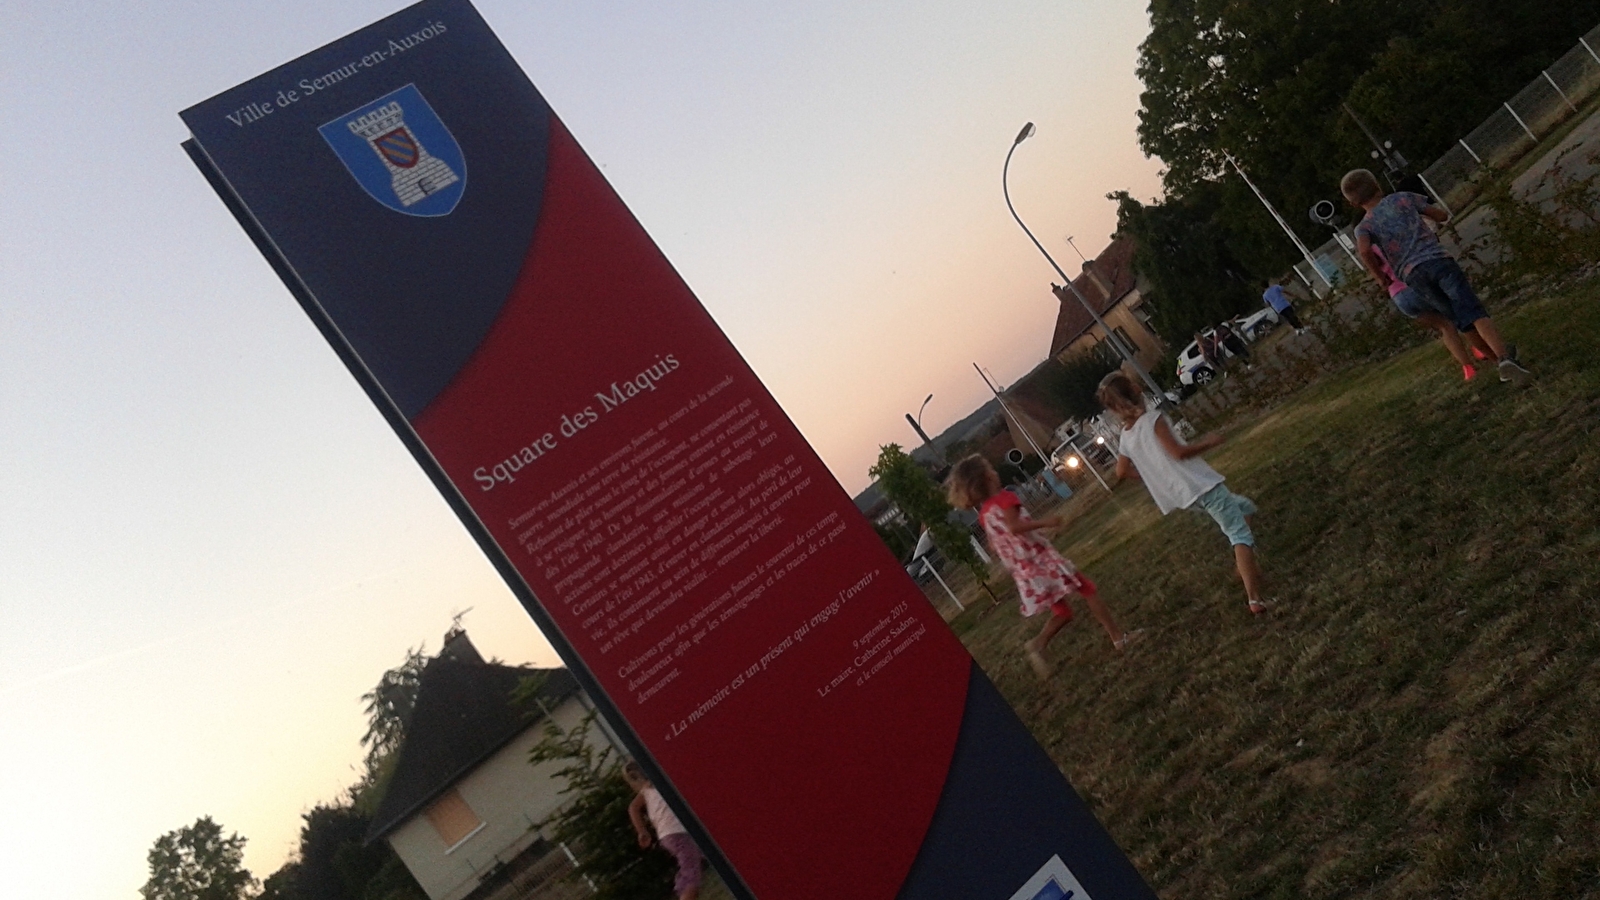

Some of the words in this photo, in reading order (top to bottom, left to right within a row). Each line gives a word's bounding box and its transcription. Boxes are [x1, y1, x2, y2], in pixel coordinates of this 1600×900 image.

[225, 101, 274, 128] Ville
[276, 90, 300, 109] de
[299, 19, 448, 97] Semur-en-Auxois
[470, 424, 564, 498] Square
[551, 399, 600, 440] des
[592, 346, 685, 418] Maquis
[667, 715, 689, 737] La
[683, 681, 732, 724] mémoire
[728, 672, 746, 690] est
[742, 661, 761, 679] un
[754, 632, 797, 671] présent
[789, 619, 814, 644] qui
[807, 597, 844, 631] engage
[816, 682, 832, 698] Le
[852, 632, 892, 668] Catherine
[850, 638, 861, 650] 9
[856, 612, 894, 647] septembre
[887, 598, 910, 619] 2015
